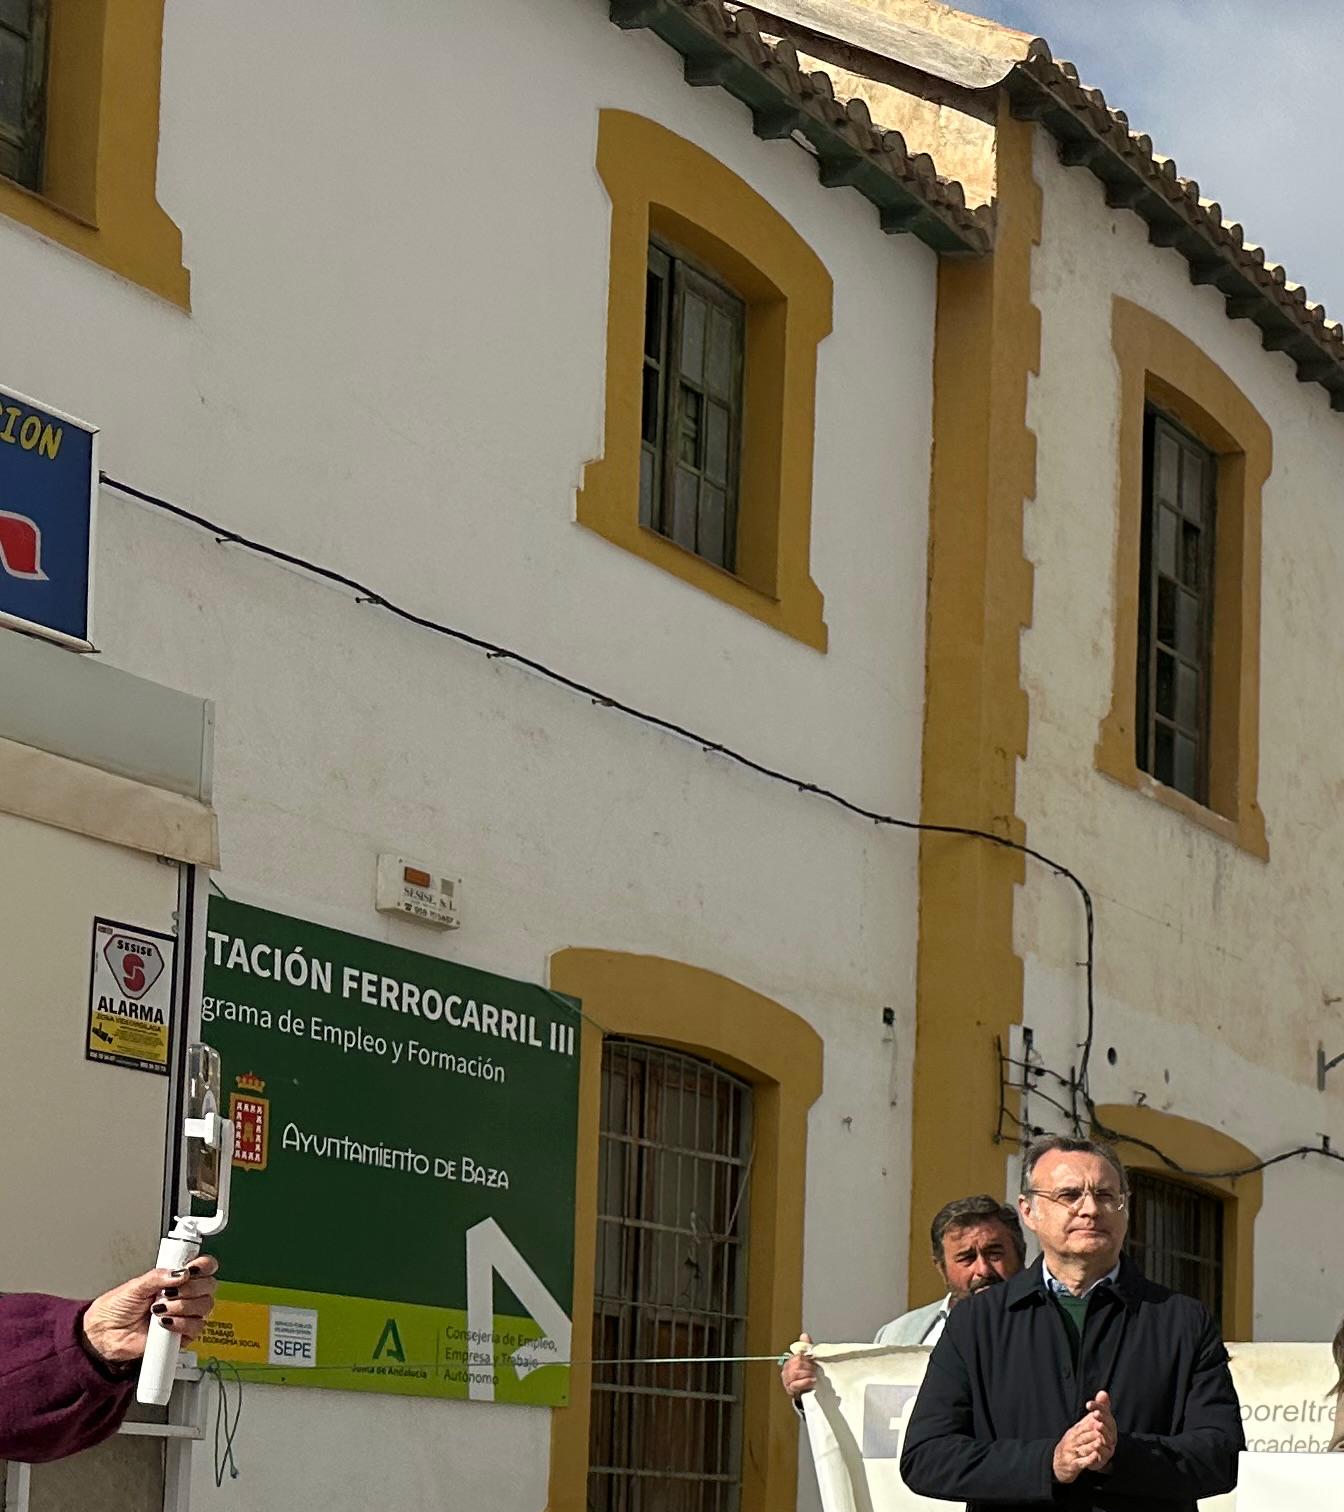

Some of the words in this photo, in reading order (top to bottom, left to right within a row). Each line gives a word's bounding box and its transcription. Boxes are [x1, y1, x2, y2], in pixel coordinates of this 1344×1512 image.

[0, 402, 63, 460] ION
[116, 939, 153, 957] SESISE
[207, 930, 332, 994] TACIÓN
[342, 965, 543, 1047] FERROCARRIL
[549, 1021, 575, 1056] III
[97, 995, 165, 1025] ALARMA
[201, 996, 272, 1029] grama
[278, 1009, 305, 1036] de
[311, 1016, 387, 1058] Empleo
[392, 1040, 404, 1065] y
[408, 1040, 506, 1084] Formación
[274, 1340, 312, 1359] SEPE
[502, 1332, 515, 1346] de
[445, 1348, 491, 1365] Empresa
